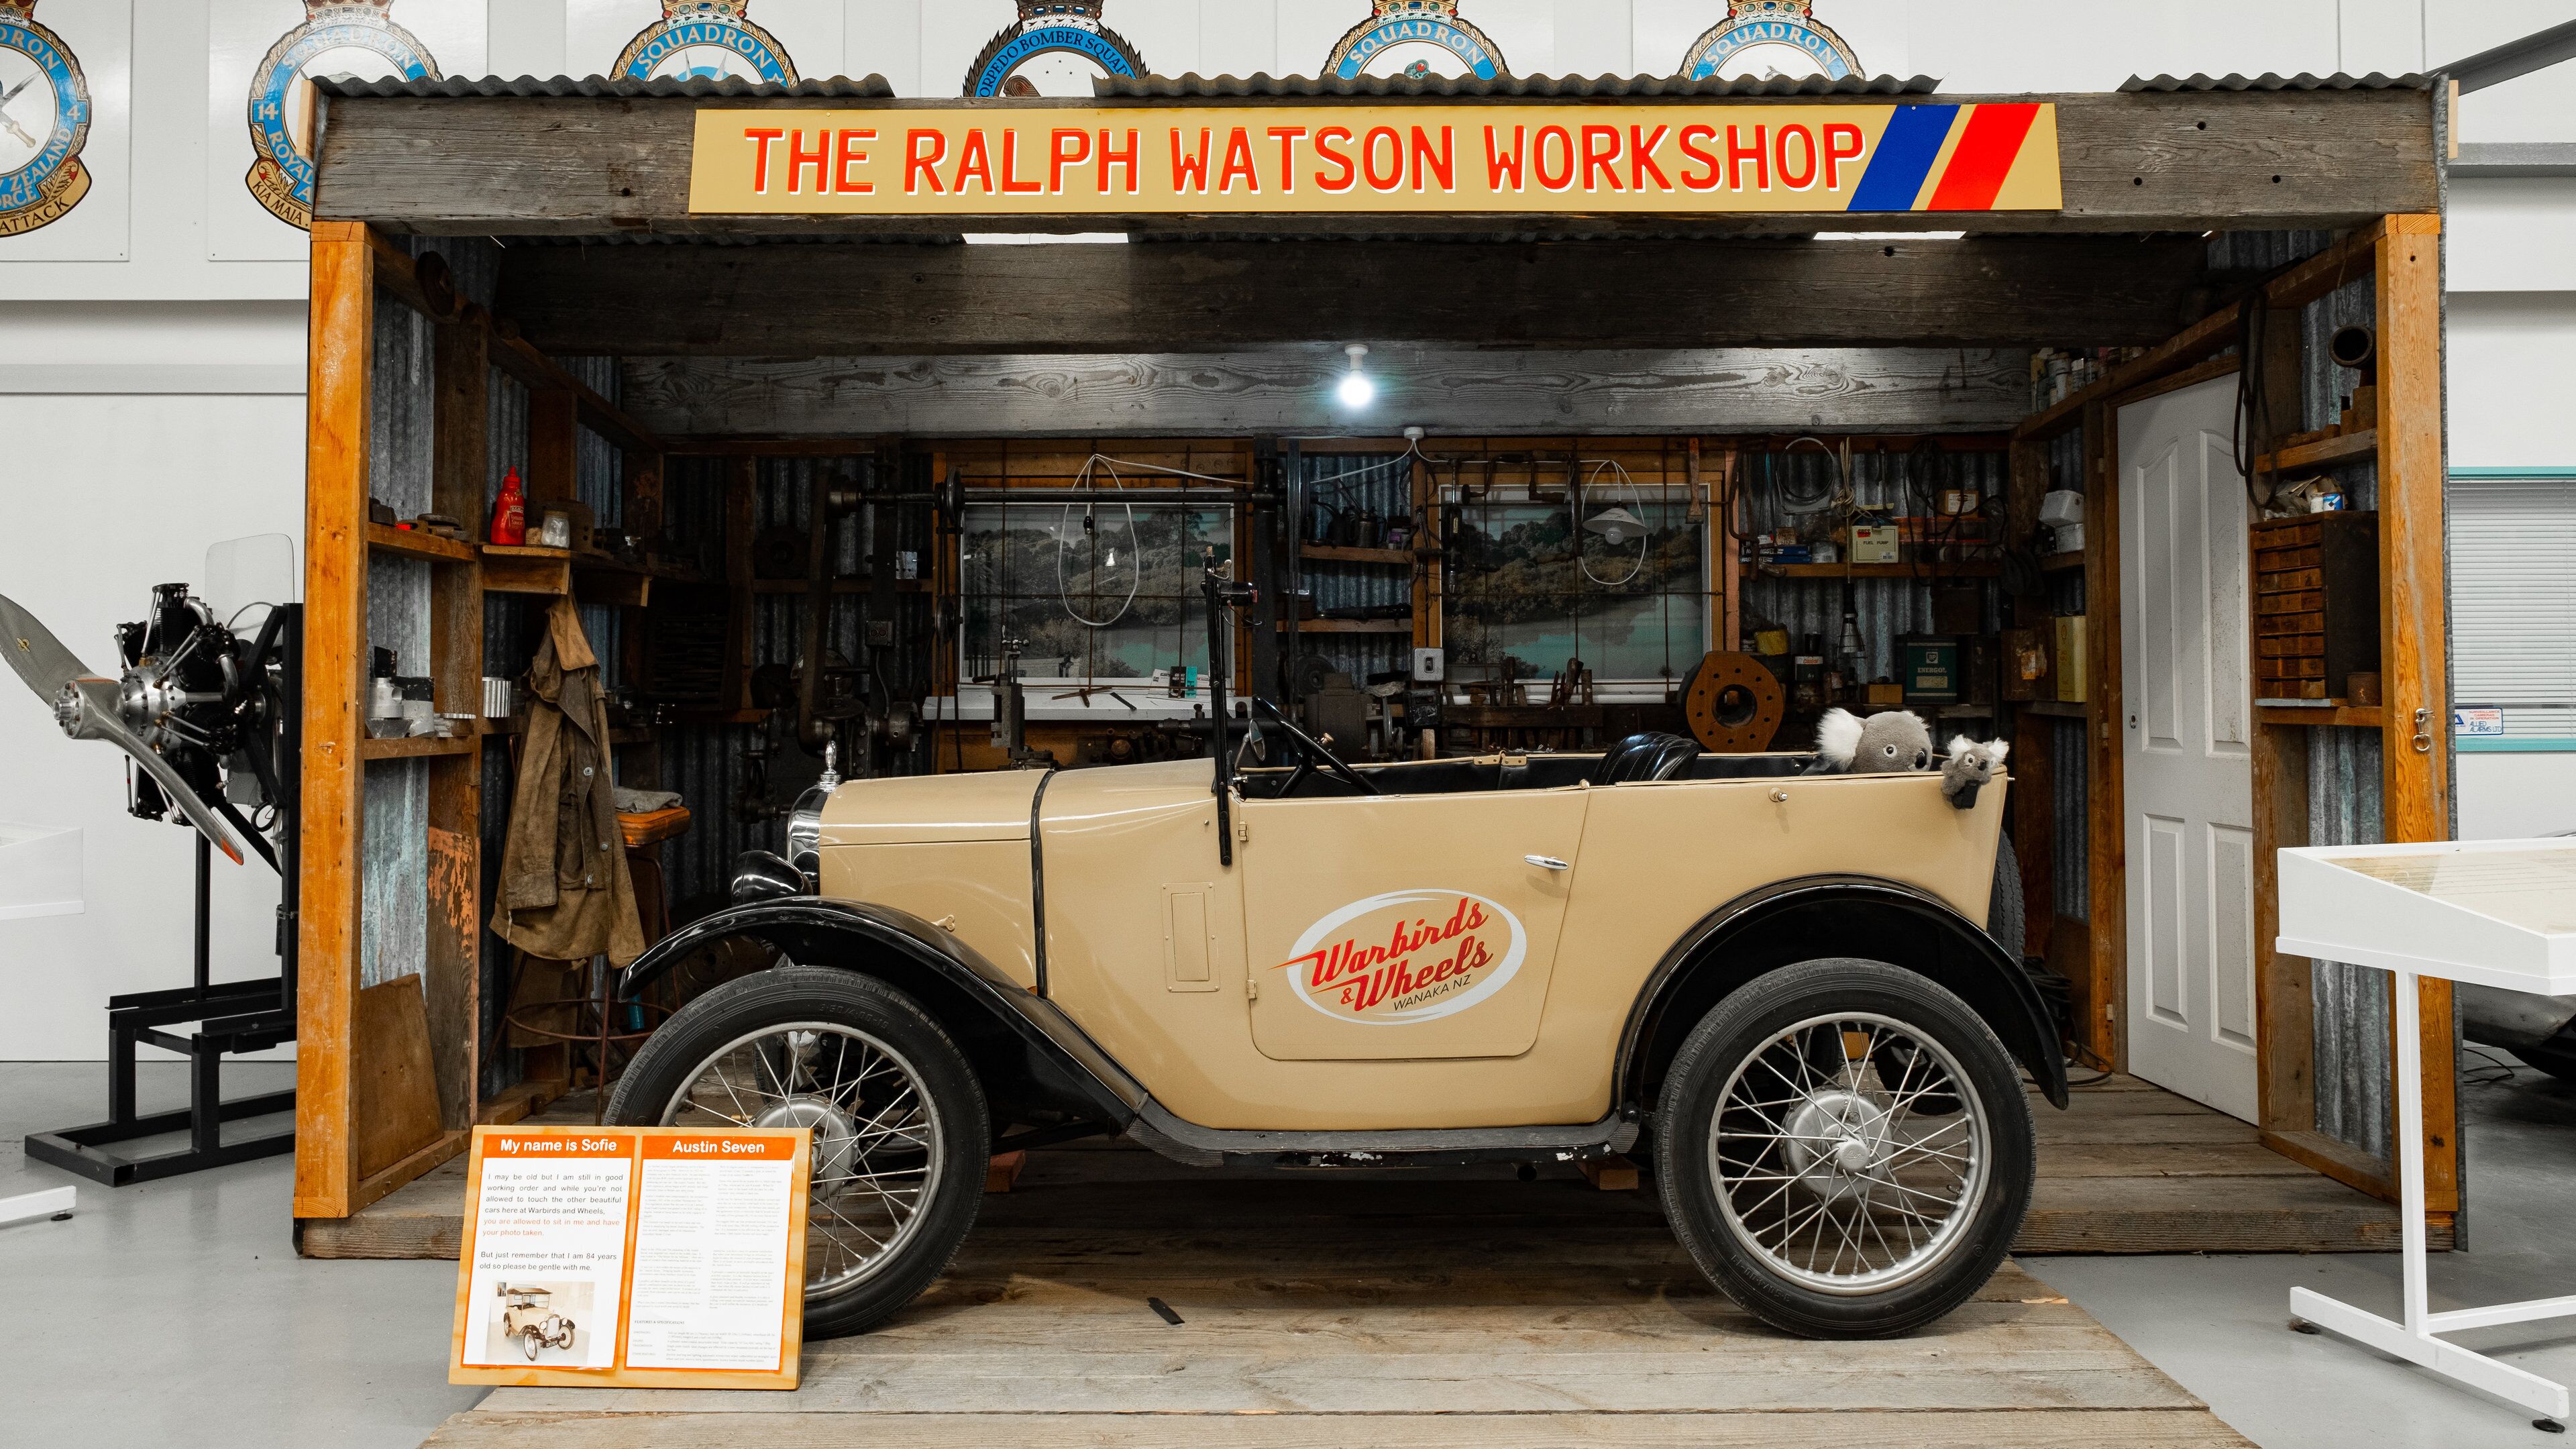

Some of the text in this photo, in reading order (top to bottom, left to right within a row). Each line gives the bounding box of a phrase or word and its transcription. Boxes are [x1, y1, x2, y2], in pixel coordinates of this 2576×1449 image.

[282, 26, 416, 70] SQUADRON
[637, 25, 773, 72] SQUADRON
[1350, 21, 1486, 65] SQUADRON
[1704, 23, 1838, 66] SQUADRON
[979, 30, 1132, 97] ORPEDO BOMBER SQUAD
[66, 104, 81, 121] 4
[258, 102, 278, 120] 14
[10, 127, 72, 192] ZEALAND
[268, 130, 313, 185] ROYAL
[744, 123, 1867, 196] THE RALPH WATSON WORKSHOP
[253, 181, 271, 204] KIA
[0, 195, 70, 233] ATTACK
[1268, 897, 1489, 987] Warbirds
[1310, 935, 1493, 1012] & Wheels
[1393, 974, 1471, 1011] WANAKA NZ
[500, 1138, 616, 1154] My name is Sofie
[673, 1140, 764, 1153] Austin Seven
[487, 1185, 515, 1193] working
[584, 1185, 606, 1193] you're
[605, 1174, 623, 1182] good
[500, 1229, 521, 1237] photo
[494, 1252, 509, 1260] just
[538, 1263, 561, 1272] gentle
